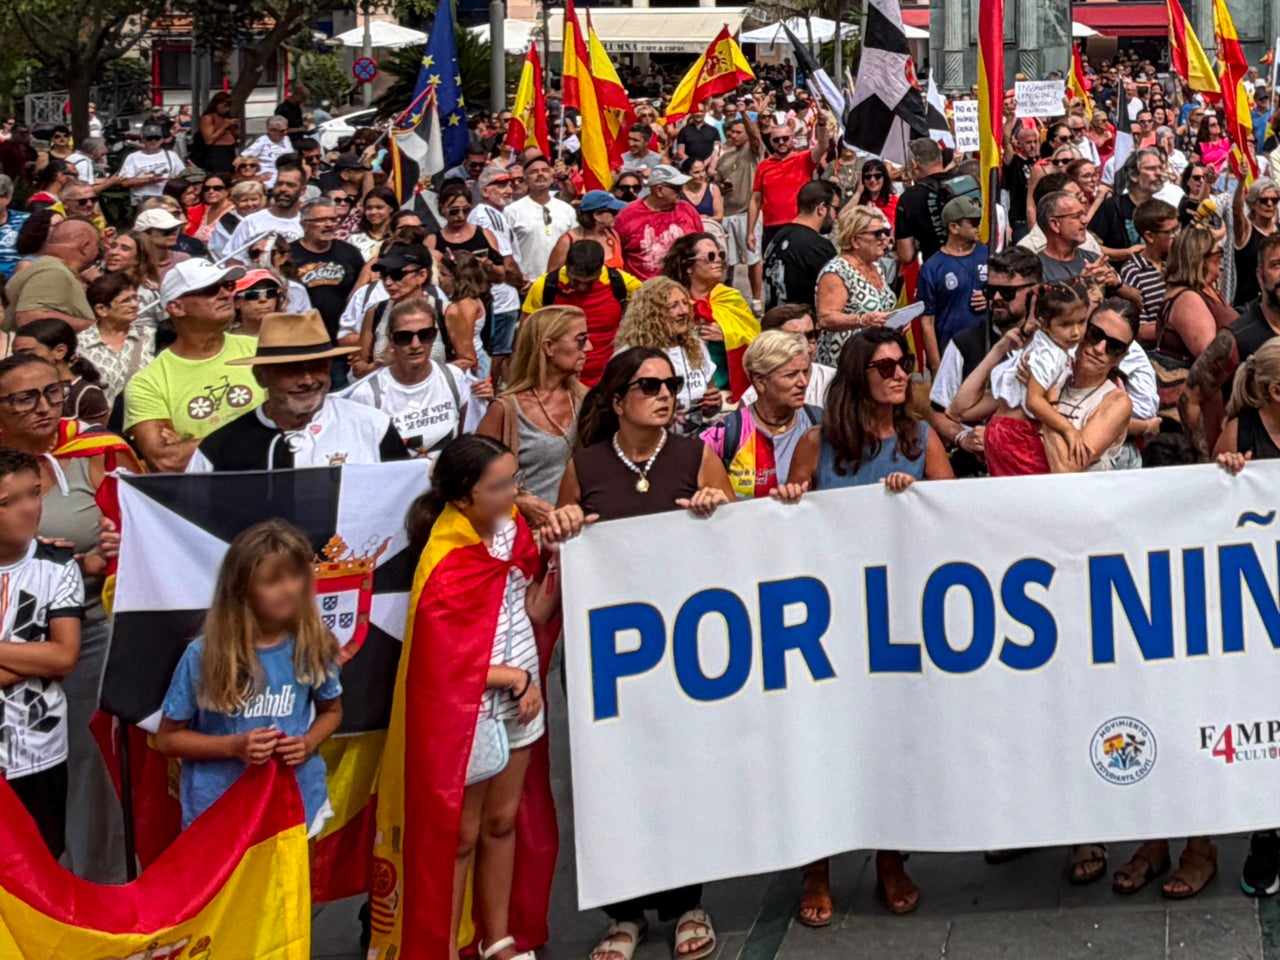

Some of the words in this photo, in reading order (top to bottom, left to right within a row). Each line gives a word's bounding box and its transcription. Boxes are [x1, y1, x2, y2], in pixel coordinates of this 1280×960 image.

[603, 42, 638, 52] LUMNA
[403, 411, 420, 422] NO
[588, 577, 834, 721] POR
[866, 558, 1058, 674] LOS
[1099, 719, 1149, 739] MOVIMIENTO
[1095, 760, 1136, 783] ESTUDIANTIL
